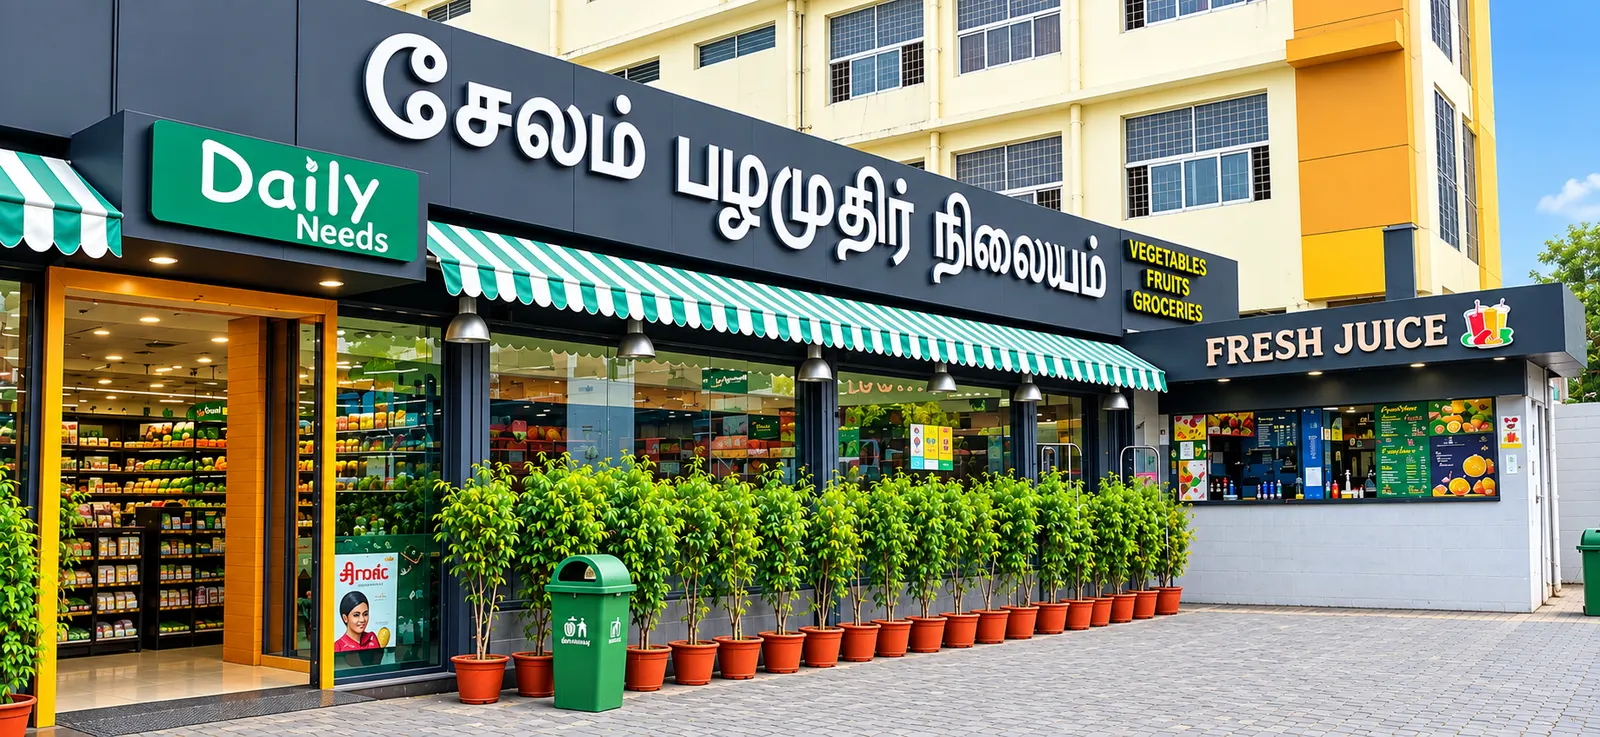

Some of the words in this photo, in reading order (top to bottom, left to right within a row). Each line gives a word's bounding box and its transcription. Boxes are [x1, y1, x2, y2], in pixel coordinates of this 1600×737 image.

[201, 139, 379, 224] Daily
[365, 32, 646, 180] சேலம்
[677, 135, 915, 266] பழமுதிர்
[933, 192, 1107, 298] நிலையம்
[296, 213, 389, 253] Needs
[1129, 239, 1208, 277] VEGETABLES
[1147, 268, 1191, 297] FRUITS
[1133, 290, 1204, 323] GROCERIES
[1205, 326, 1324, 367] FRESH
[1333, 313, 1449, 355] JUICE
